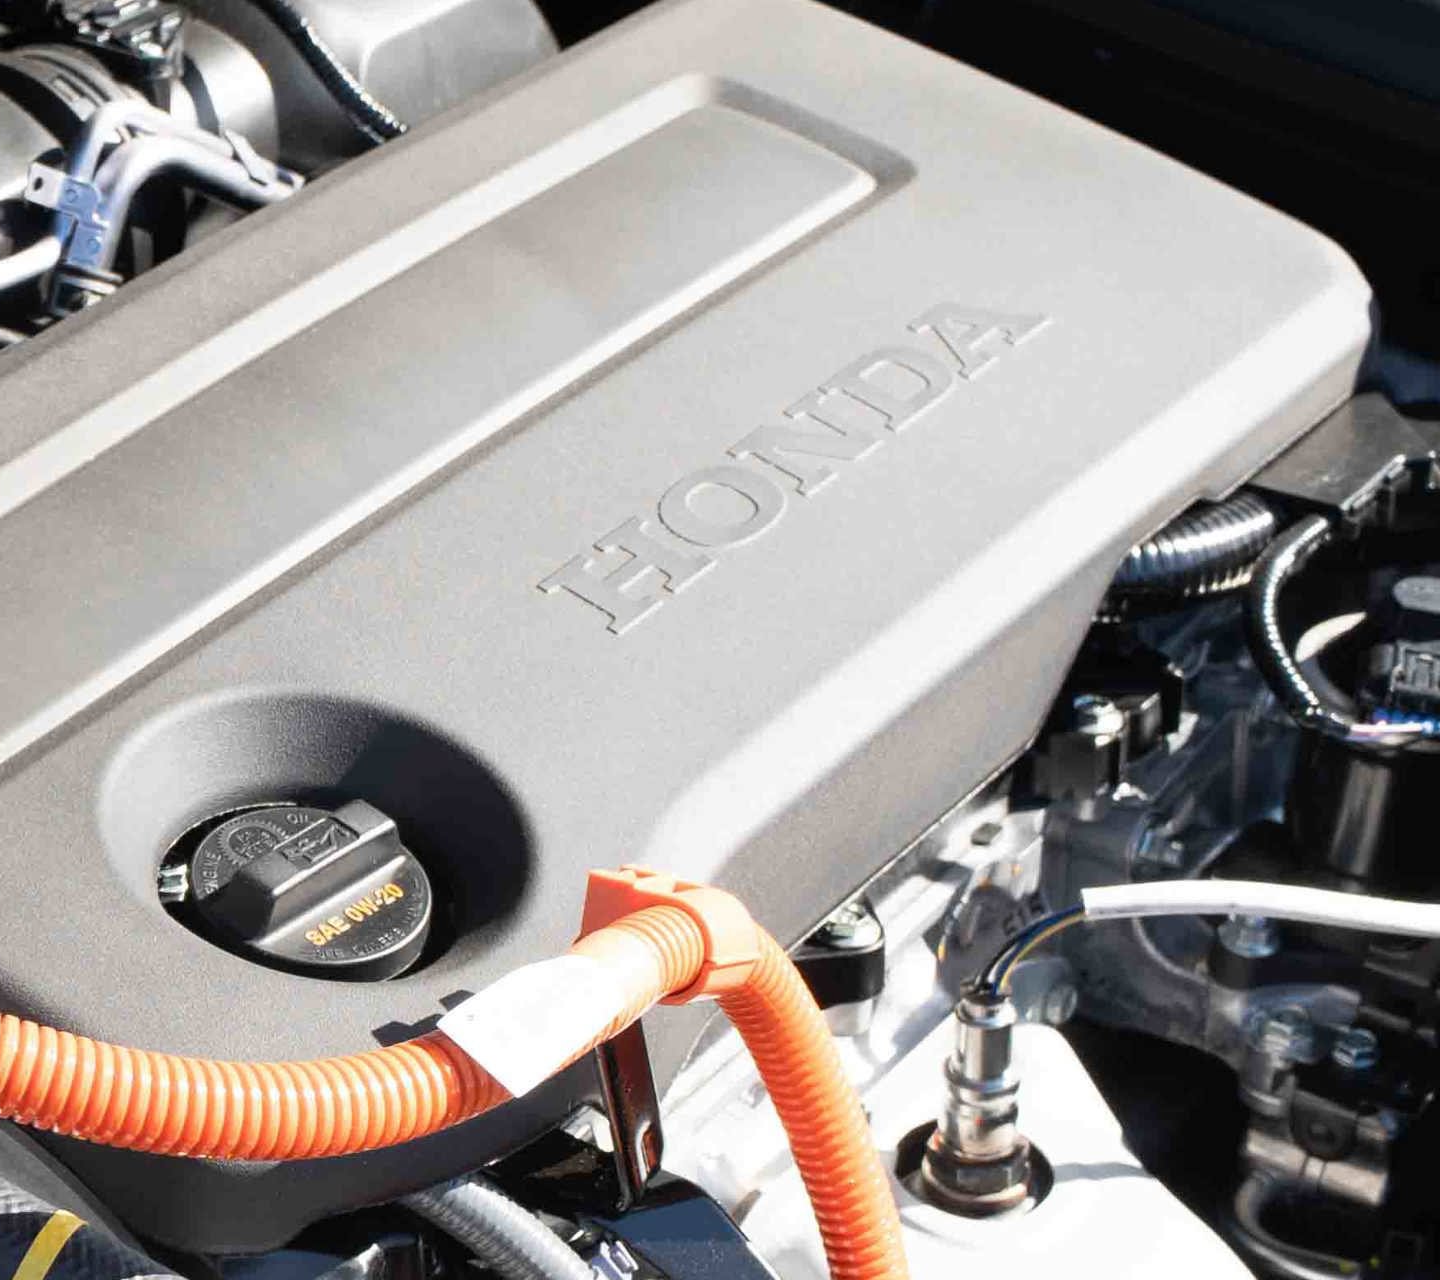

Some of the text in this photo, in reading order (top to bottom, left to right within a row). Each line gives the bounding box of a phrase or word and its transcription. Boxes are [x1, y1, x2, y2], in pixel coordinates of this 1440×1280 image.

[536, 303, 1052, 634] HONDA
[202, 812, 309, 894] ENGINE OIL
[304, 914, 351, 947] SAE
[344, 882, 406, 923] 0W-20
